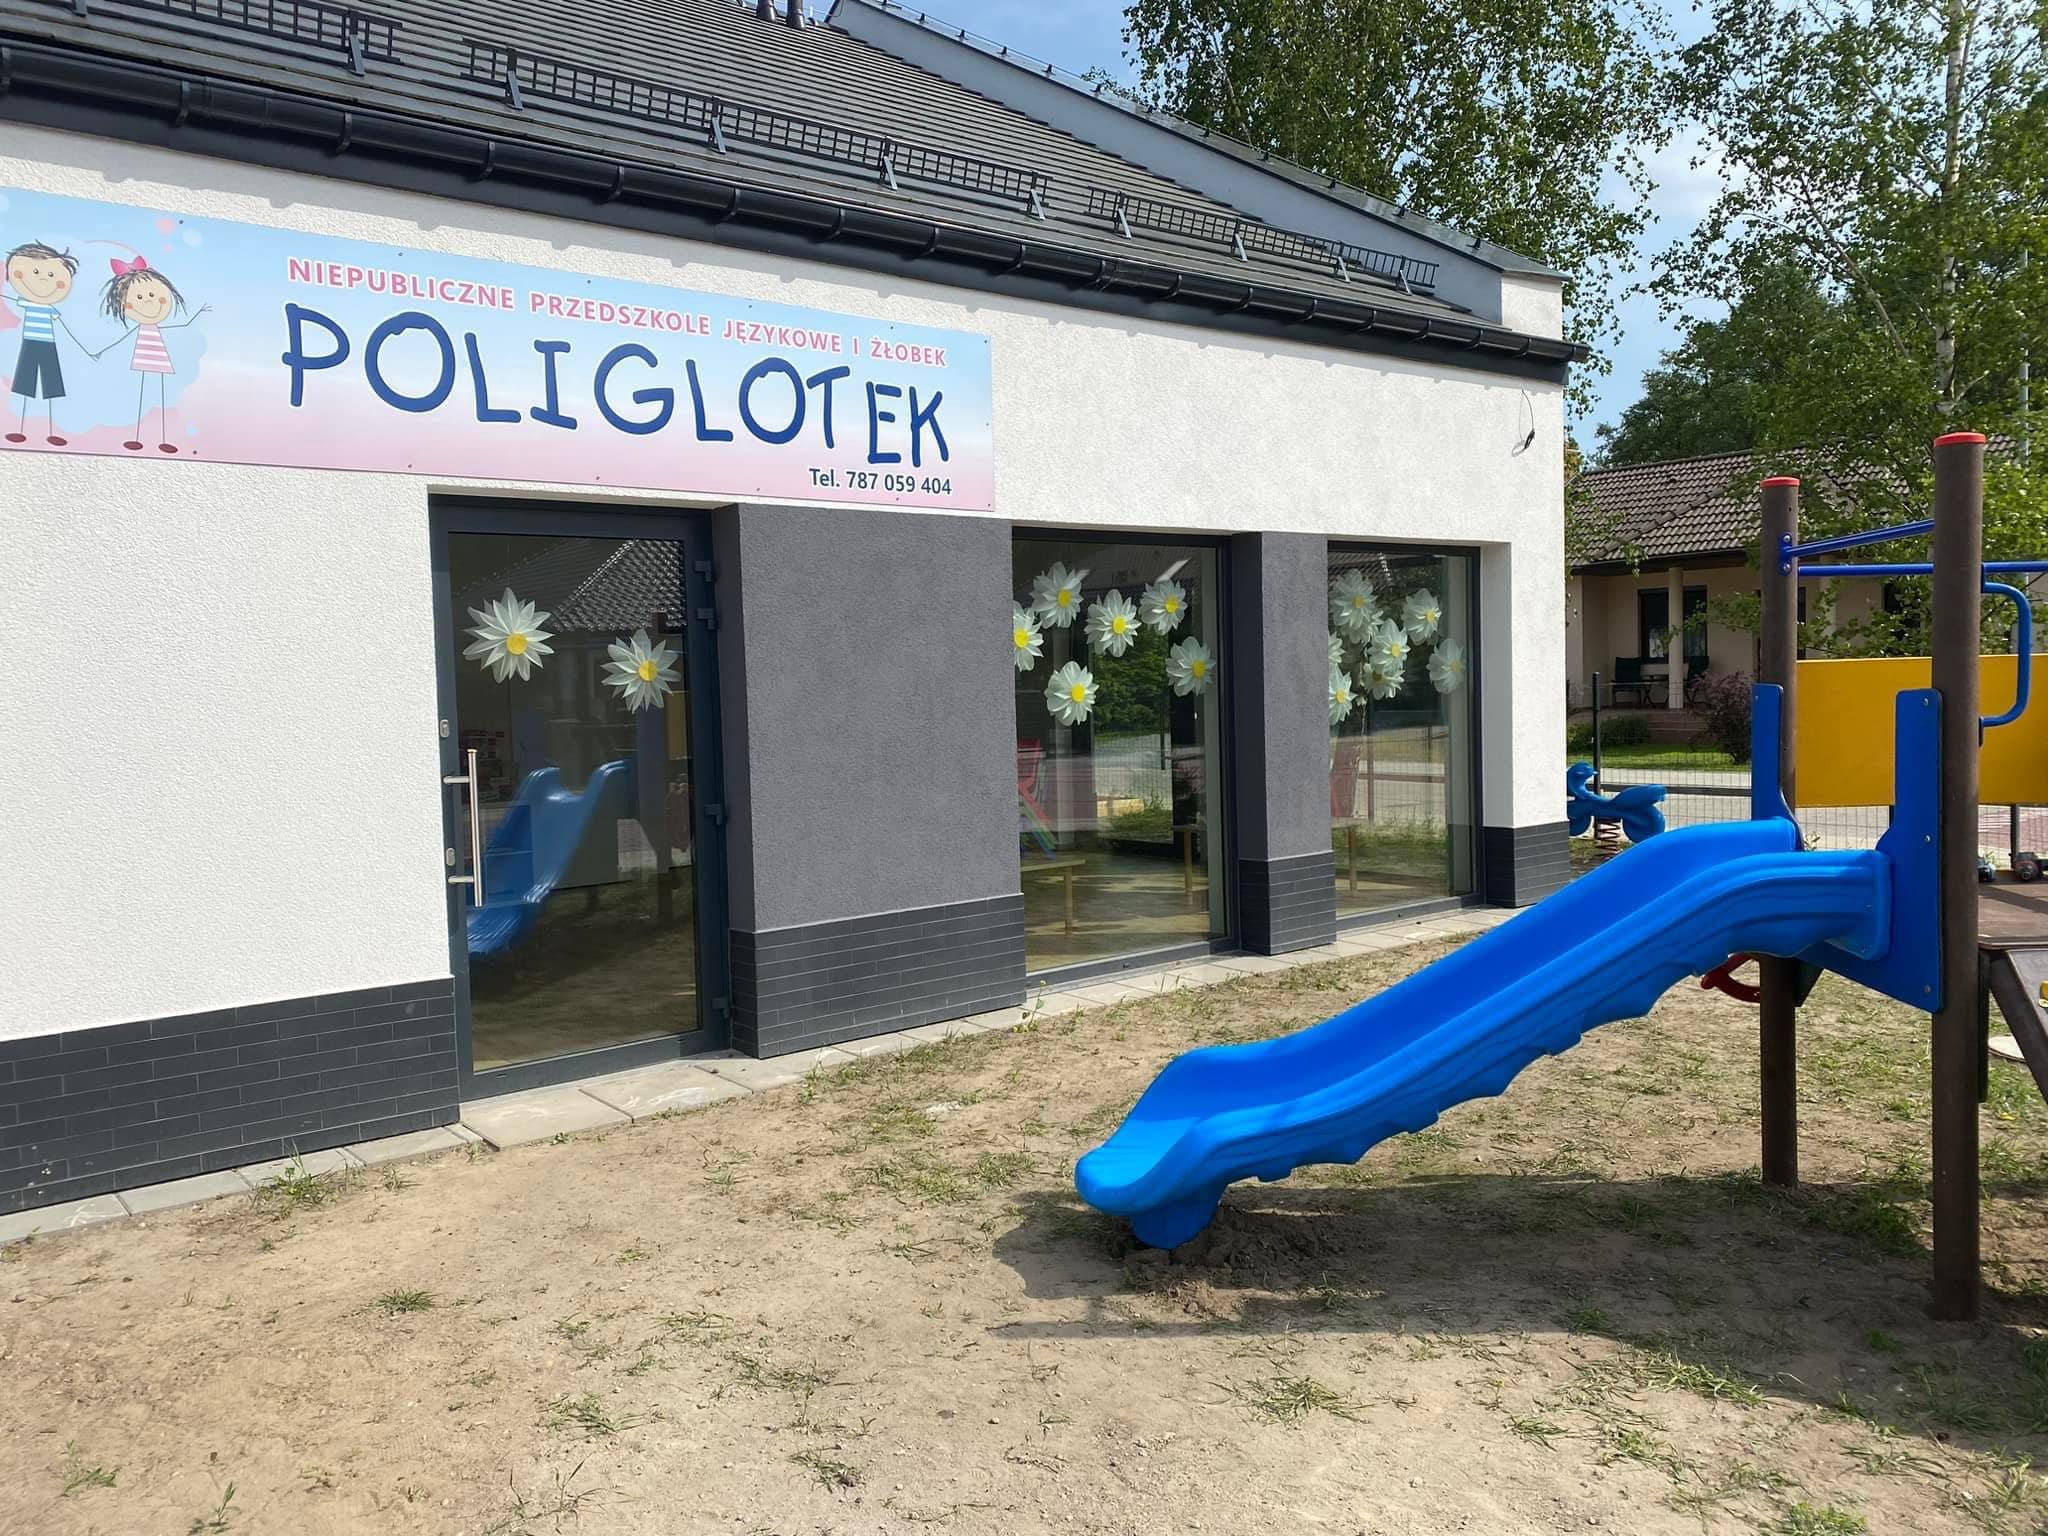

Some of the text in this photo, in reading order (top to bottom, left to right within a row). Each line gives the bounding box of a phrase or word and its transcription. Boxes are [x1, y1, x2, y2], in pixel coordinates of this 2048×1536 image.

[289, 258, 945, 366] NIEPUBLICZNE PRZEDSZKOLE JĘZYKOWE I ŻŁOBEK
[282, 303, 949, 467] POLIGLOTEK
[810, 468, 952, 494] Tel. 787 059 404
